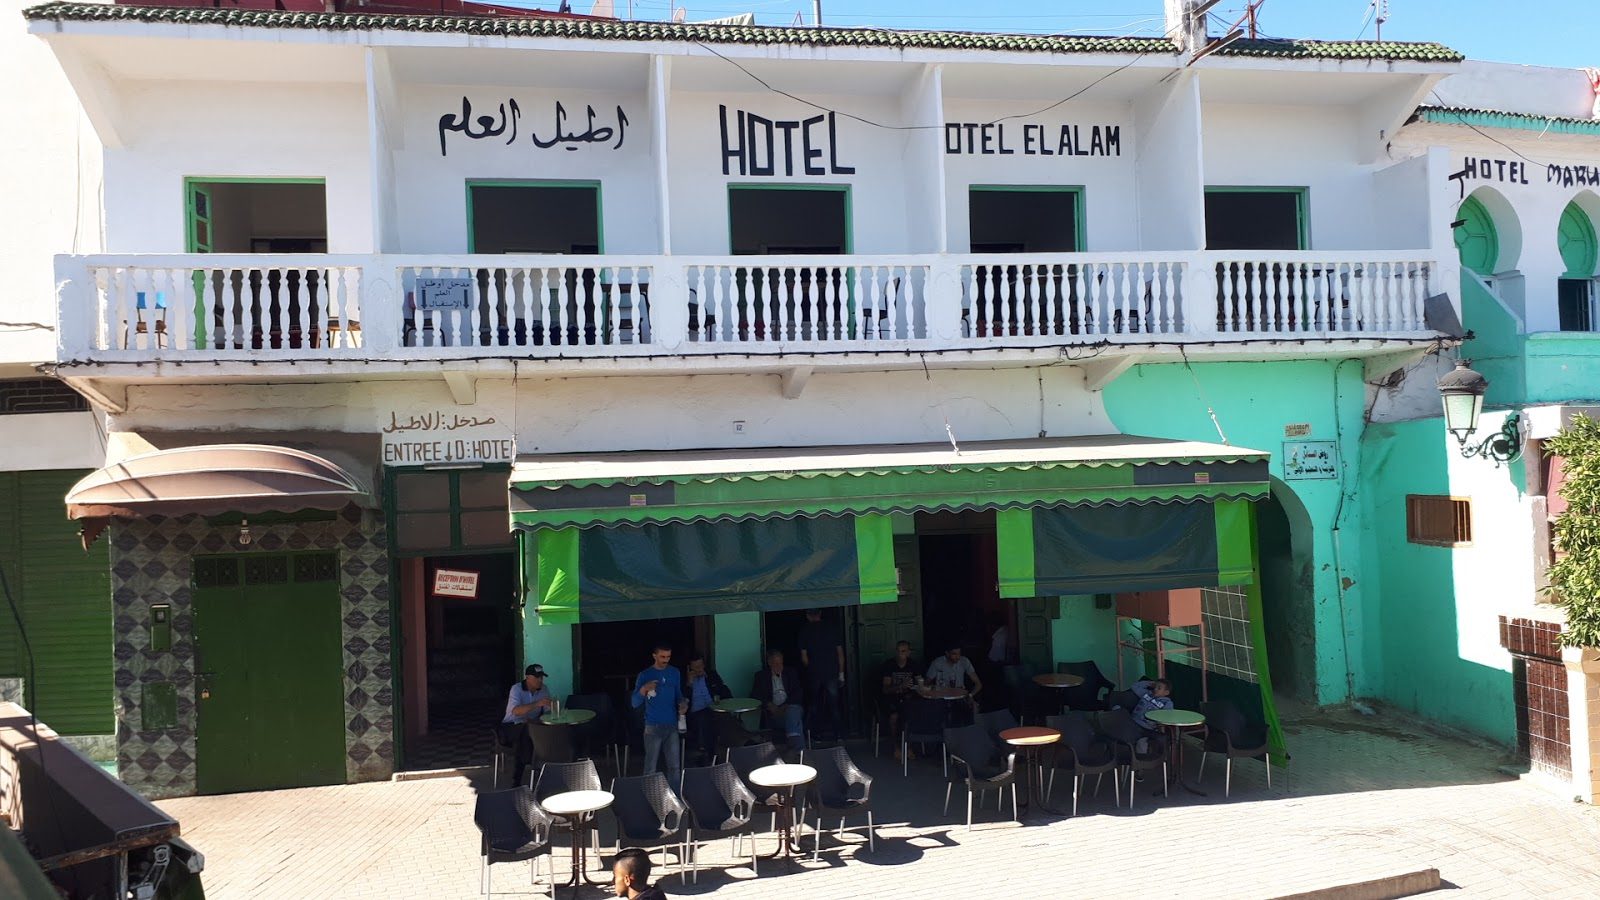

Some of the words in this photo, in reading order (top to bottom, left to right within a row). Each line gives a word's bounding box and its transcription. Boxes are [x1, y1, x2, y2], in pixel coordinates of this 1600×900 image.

[438, 96, 521, 156] العلم
[719, 104, 856, 177] HOTEL
[945, 123, 1014, 155] OTEL
[1464, 156, 1529, 185] HOTEL
[384, 441, 442, 462] ENTREE
